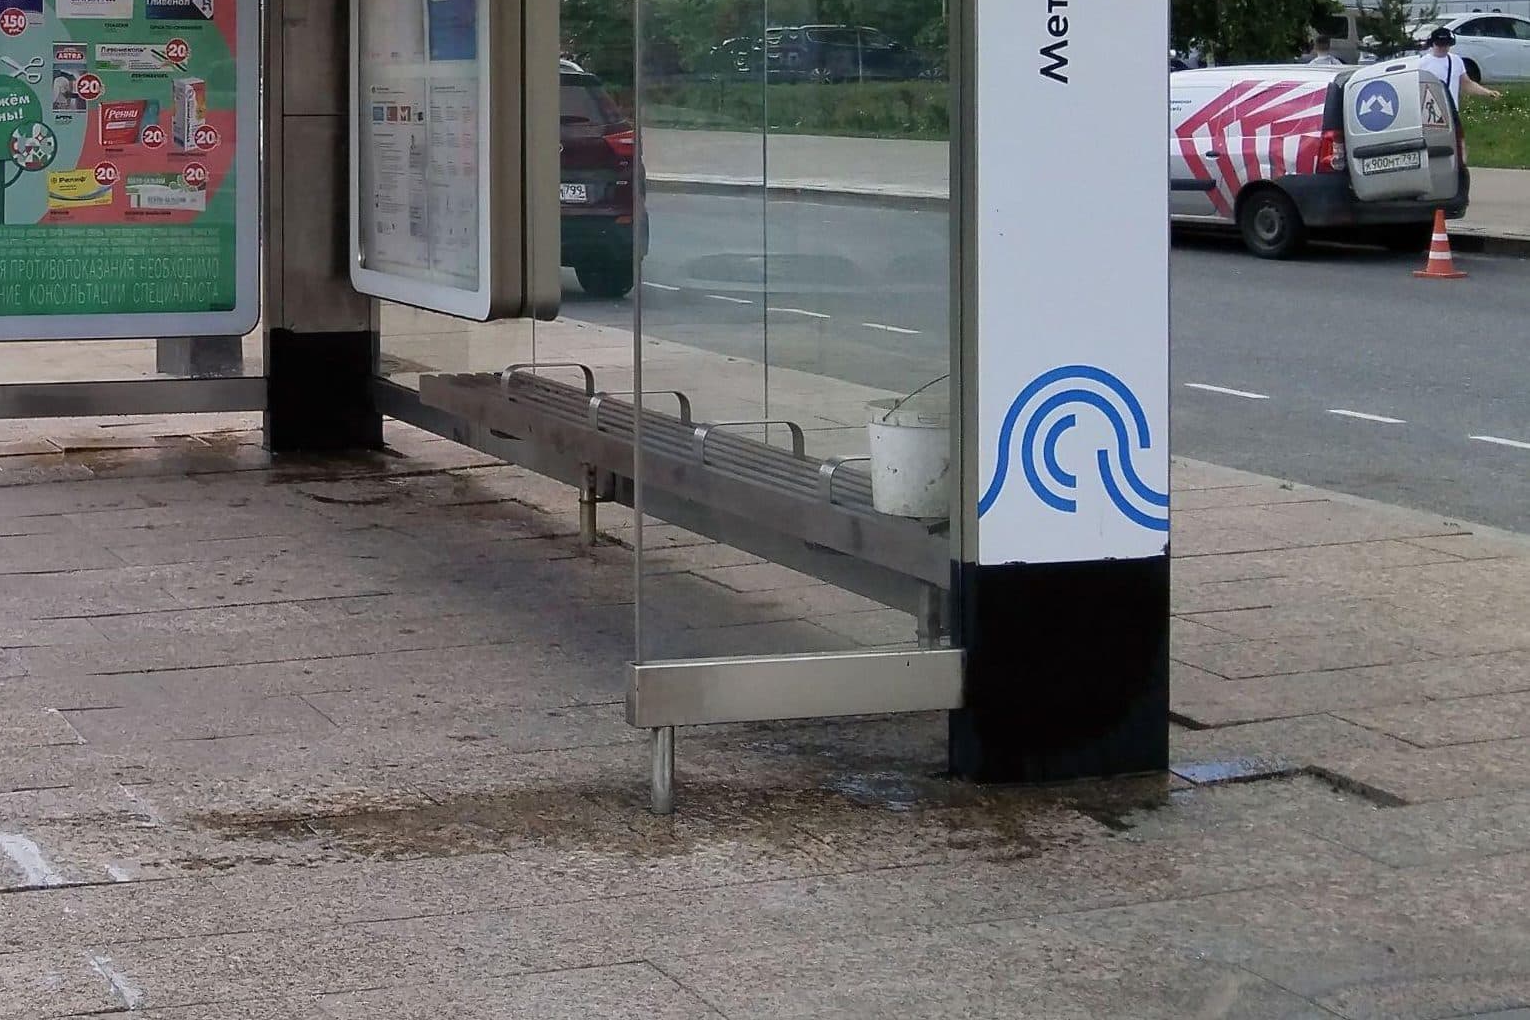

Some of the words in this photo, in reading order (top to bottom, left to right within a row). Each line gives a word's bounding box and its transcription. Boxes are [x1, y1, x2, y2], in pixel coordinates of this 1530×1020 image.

[11, 258, 135, 280] ПРОТИВОПОКАЗАНИЯ
[140, 257, 219, 279] НЕОБХОДИМО
[30, 283, 126, 305] КОНСУЛЬТАЦИИ
[133, 282, 219, 304] СПЕЦИАЛИСТА
